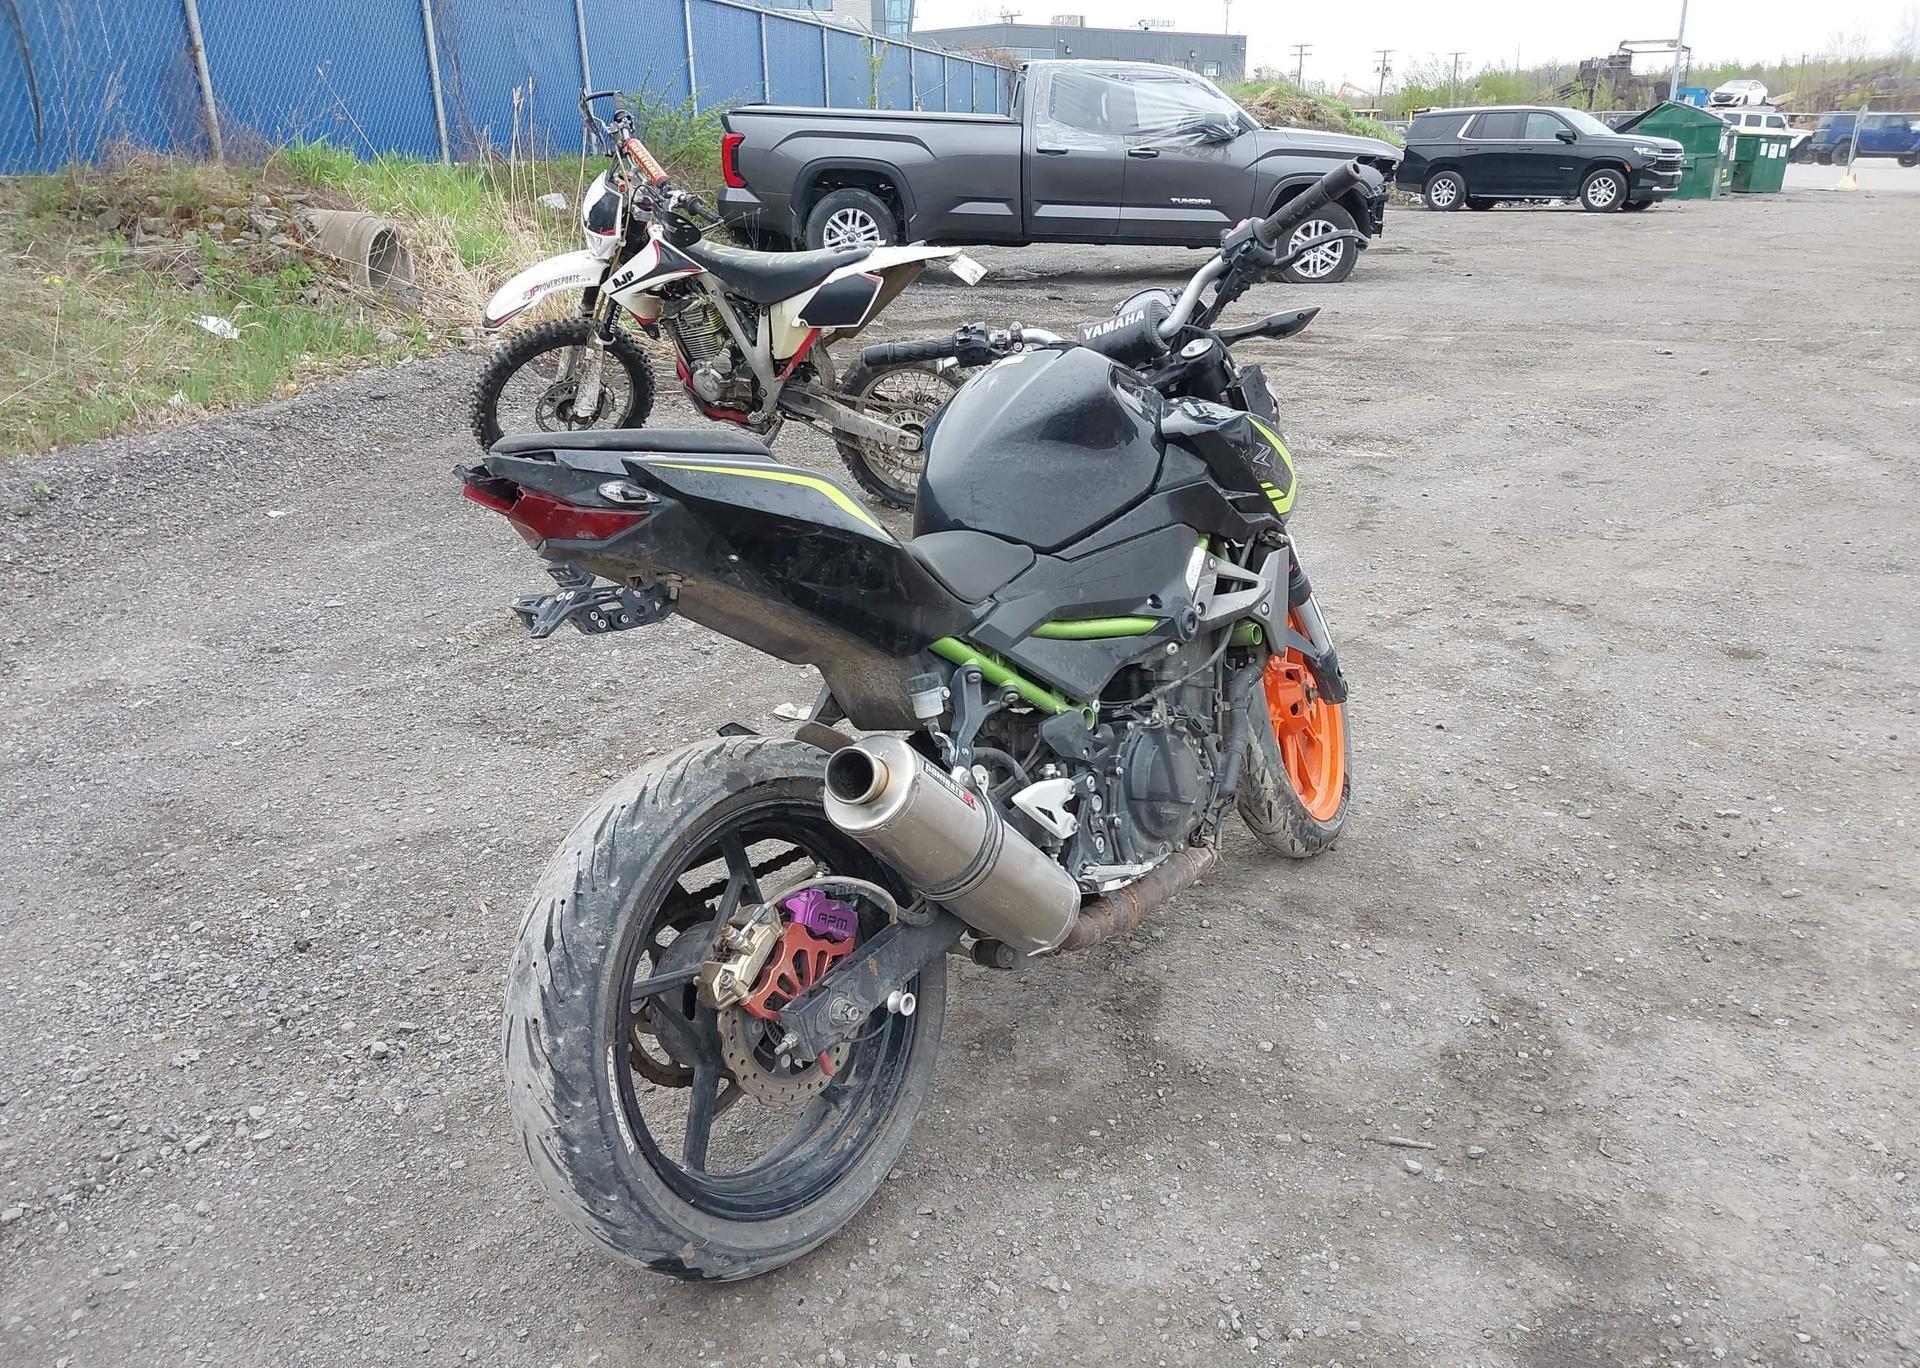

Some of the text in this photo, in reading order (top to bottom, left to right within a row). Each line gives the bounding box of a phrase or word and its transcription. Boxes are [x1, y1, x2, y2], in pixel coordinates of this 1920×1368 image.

[1170, 197, 1212, 205] TUNDRA
[539, 274, 580, 293] POWERSPORTS
[612, 270, 634, 288] AJP
[1083, 309, 1145, 340] YAMAHA
